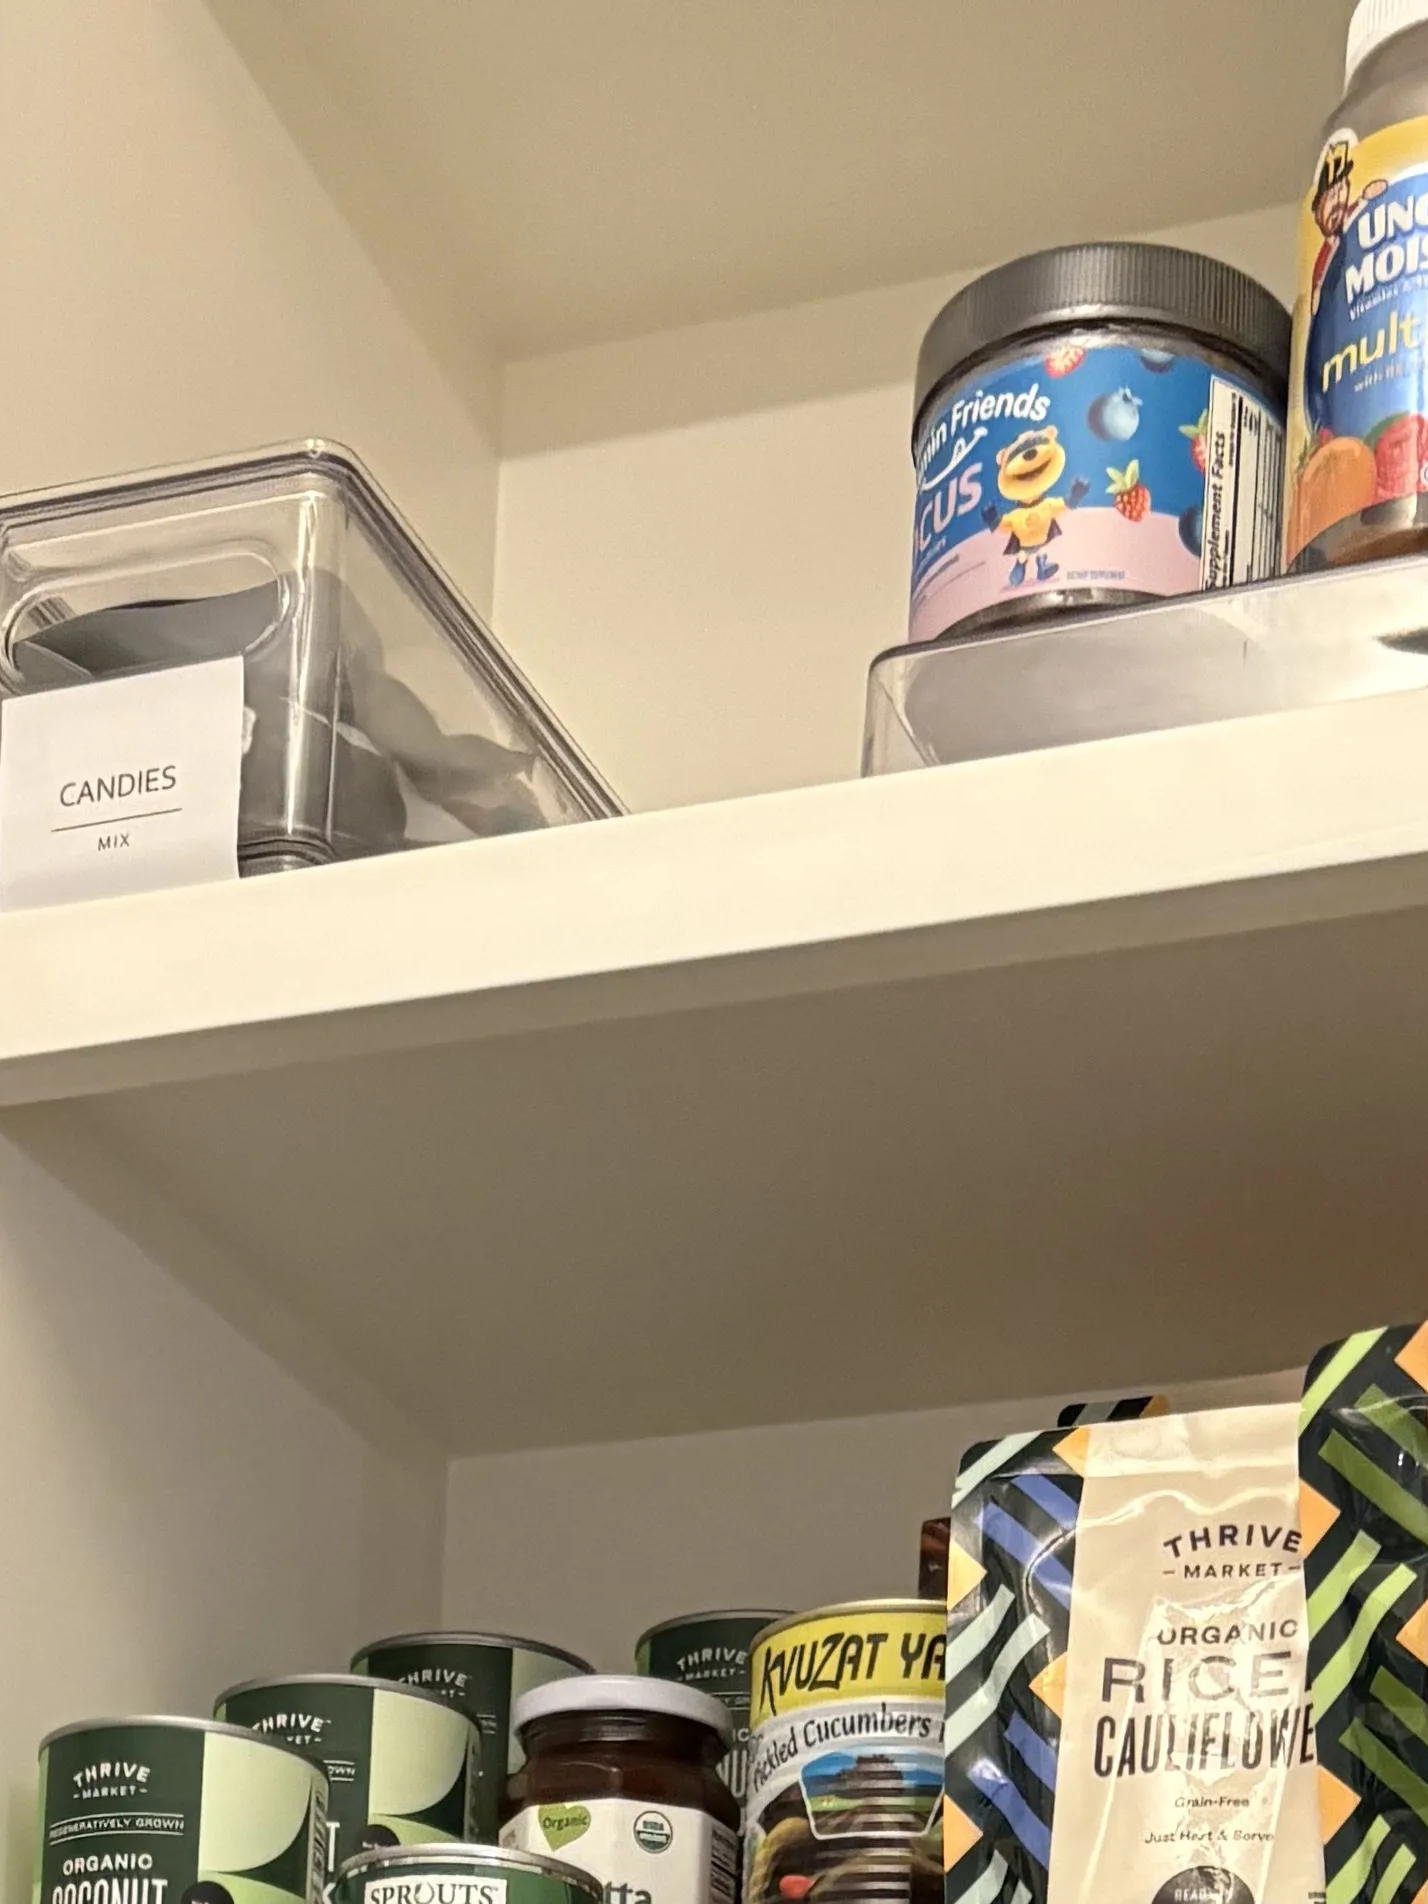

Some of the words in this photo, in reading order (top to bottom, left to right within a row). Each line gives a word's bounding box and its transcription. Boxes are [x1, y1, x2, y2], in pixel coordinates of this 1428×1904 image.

[951, 383, 1051, 426] Friends
[1210, 431, 1226, 475] Facts
[60, 765, 177, 808] CANDIES
[98, 833, 130, 852] MIX
[1163, 1522, 1302, 1560] THRIVE
[1184, 1562, 1283, 1580] MARKET
[1157, 1618, 1299, 1647] ORGANIC
[677, 1646, 749, 1672] THRIVE
[759, 1631, 889, 1717] KVUZAT
[803, 1702, 932, 1747] Cucumbers
[73, 1761, 151, 1788] THRIVE
[82, 1785, 136, 1800] MARKET
[135, 1818, 184, 1831] GROWN
[542, 1815, 588, 1830] Organic
[63, 1853, 153, 1876] ORGANIC
